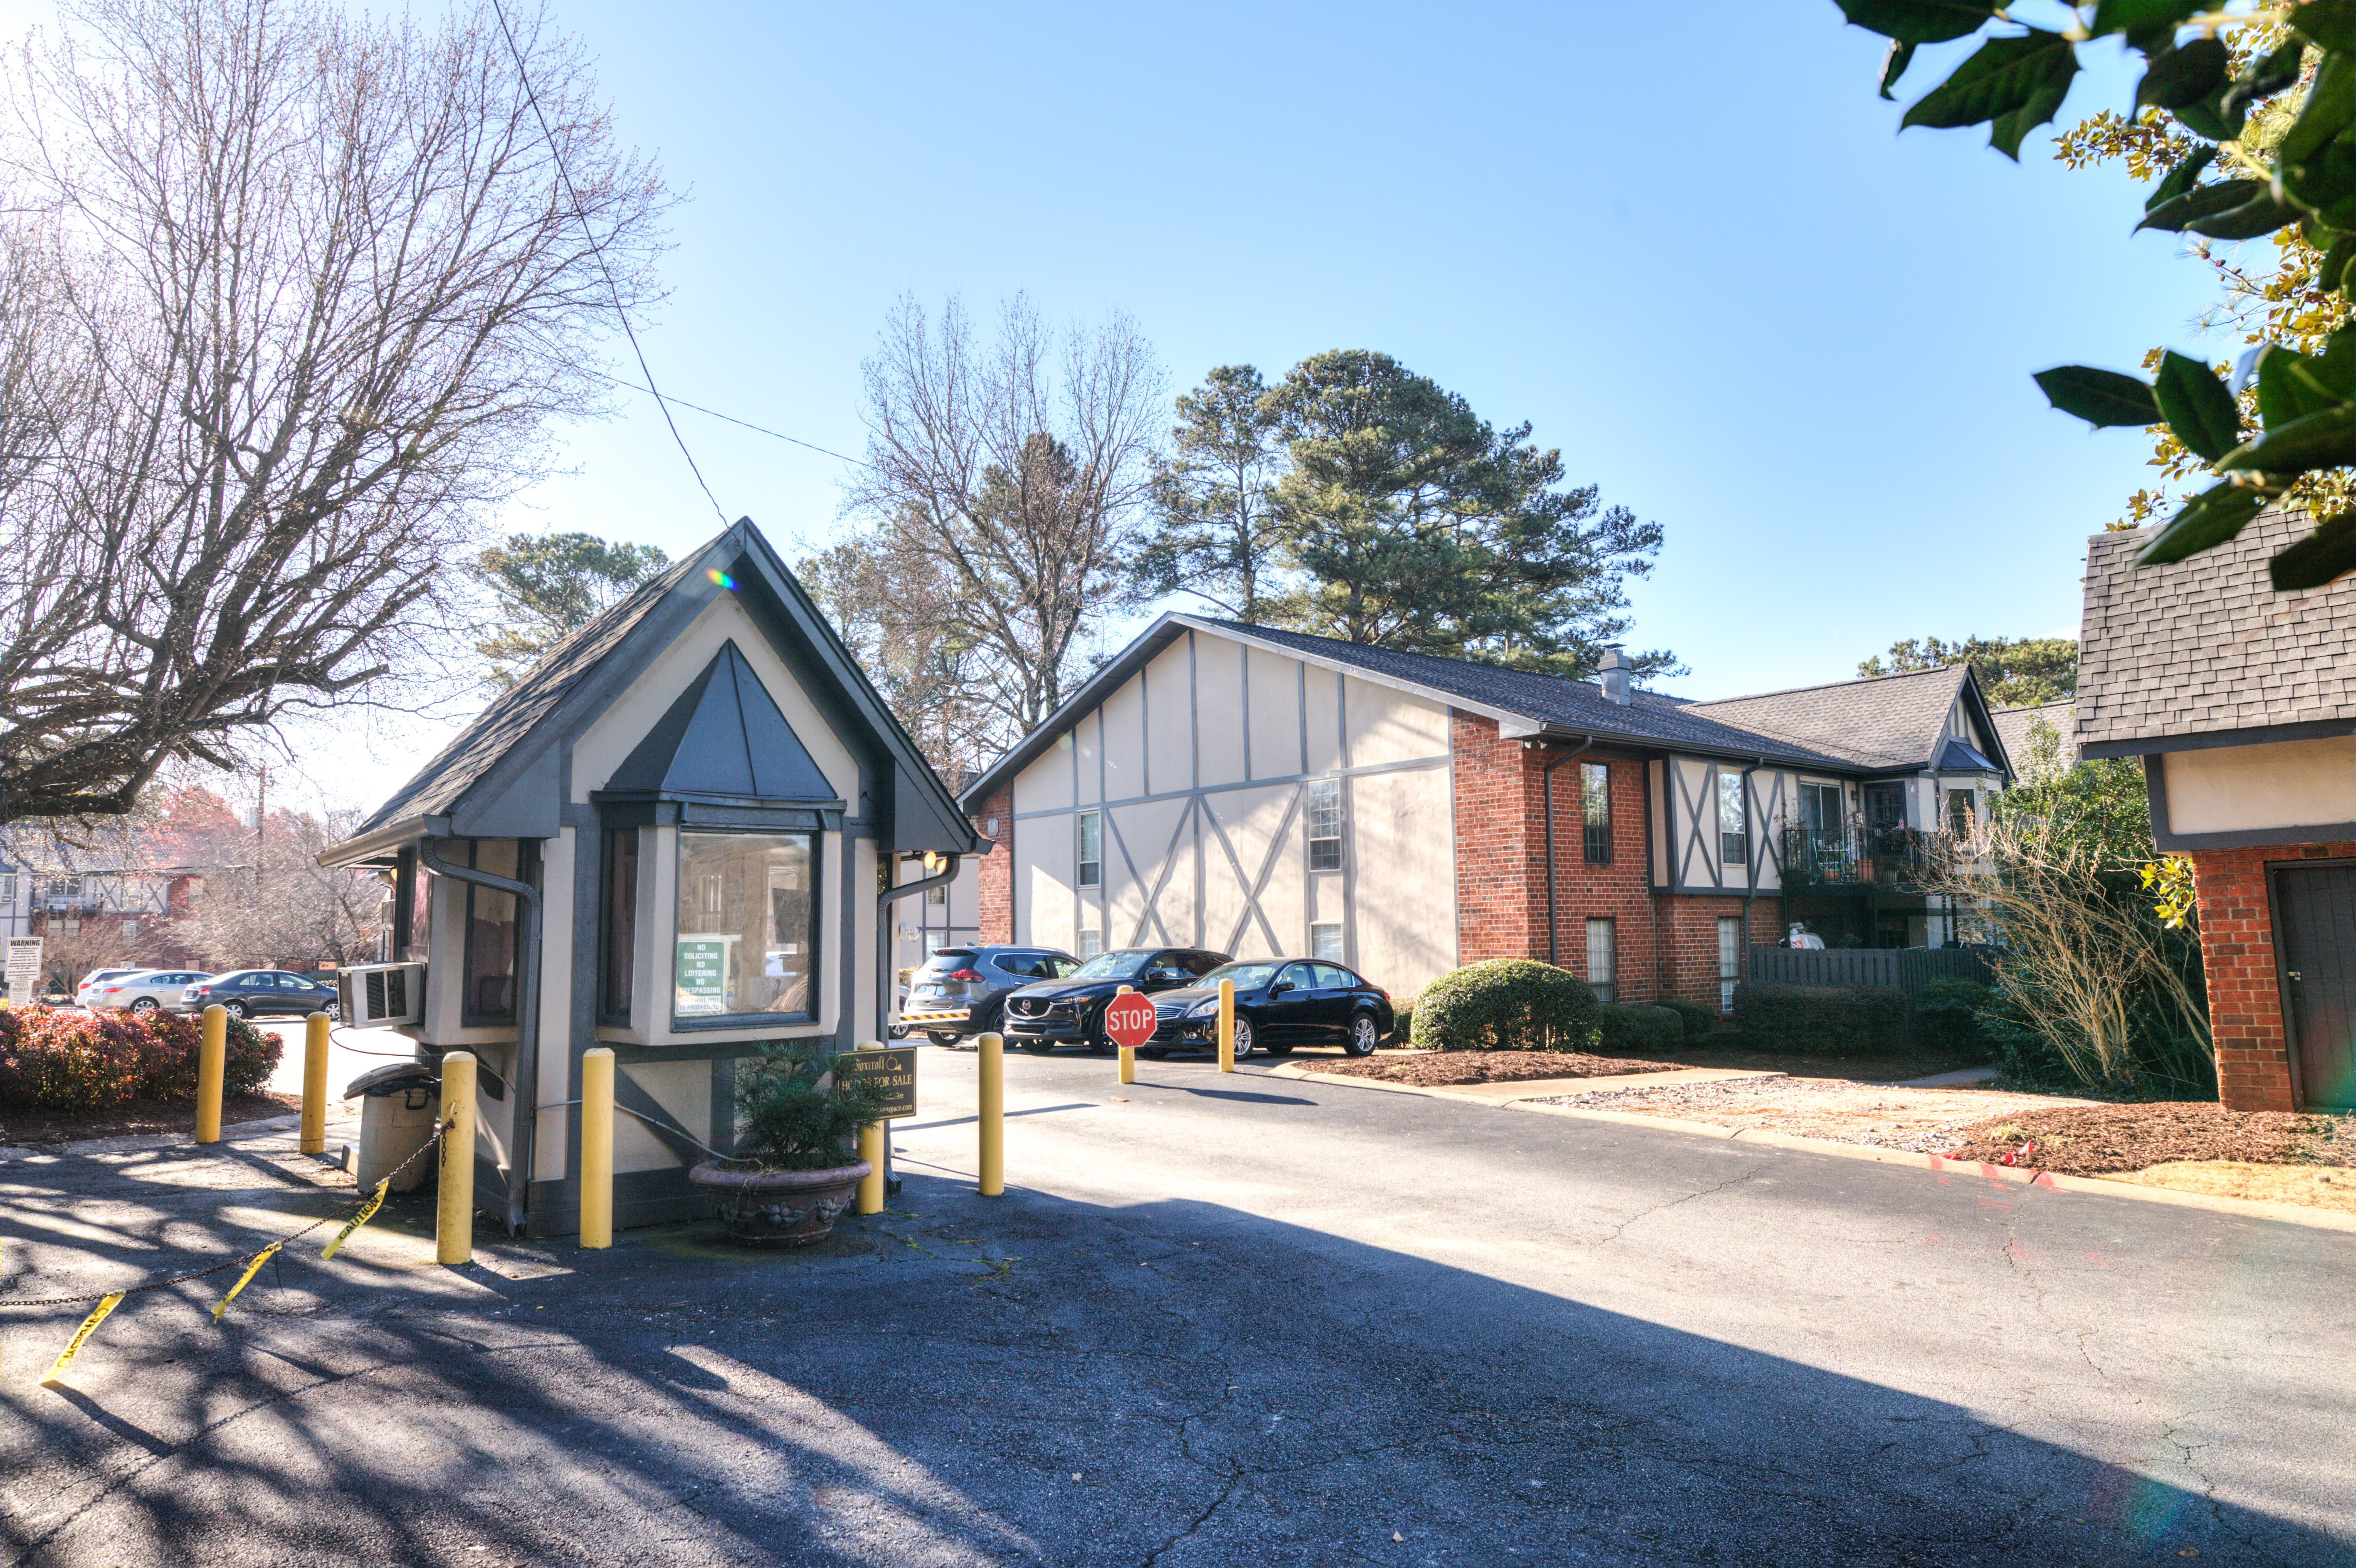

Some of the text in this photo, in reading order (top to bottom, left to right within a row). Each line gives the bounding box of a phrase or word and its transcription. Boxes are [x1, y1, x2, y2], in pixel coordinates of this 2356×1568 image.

[1110, 1009, 1153, 1031] STOP
[874, 1076, 890, 1087] FOR
[893, 1074, 912, 1086] SALE
[339, 1197, 379, 1239] CAUTION
